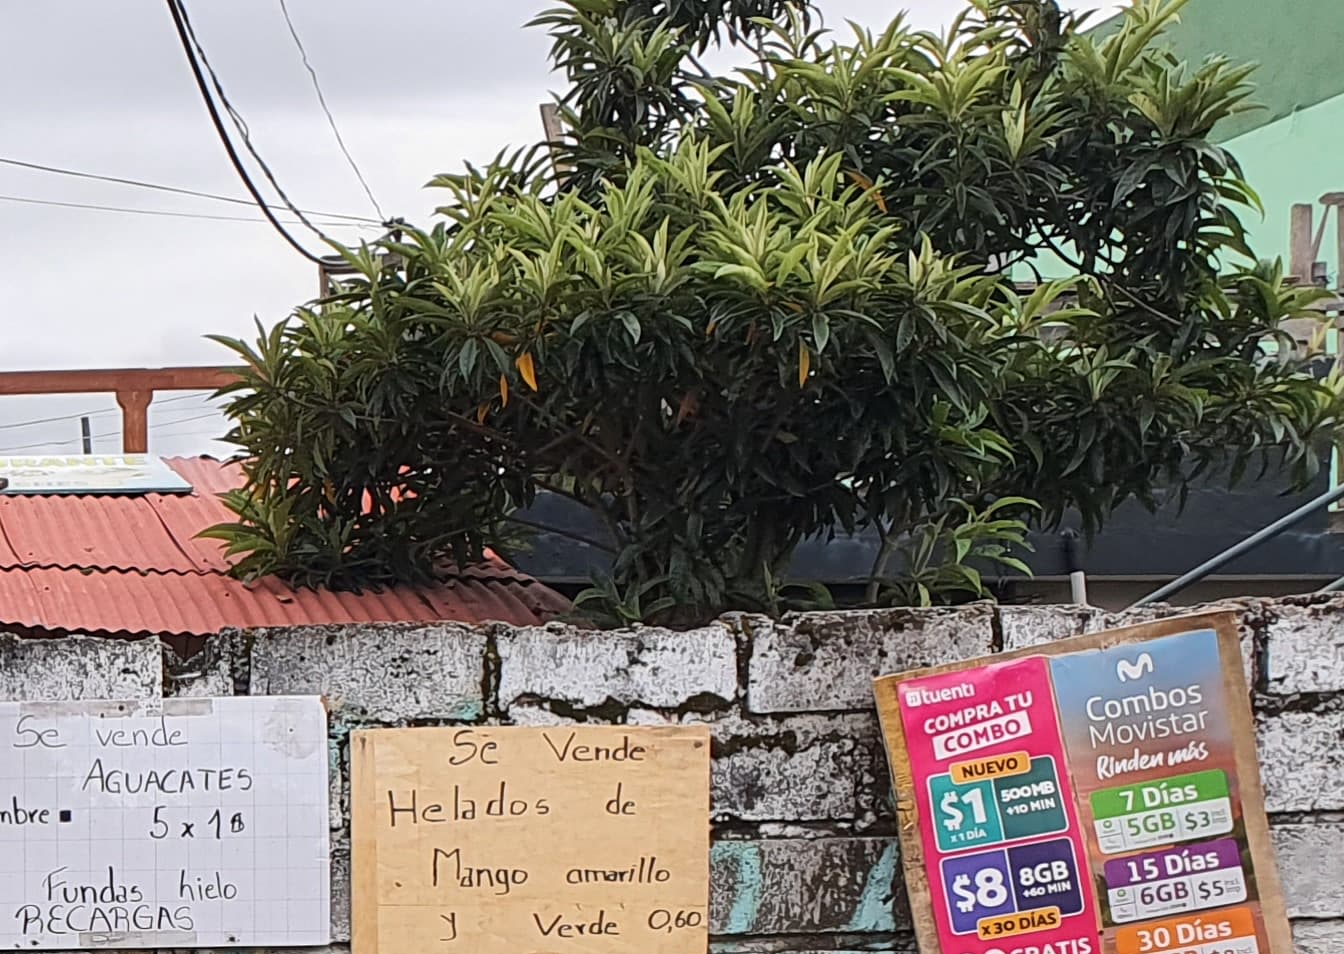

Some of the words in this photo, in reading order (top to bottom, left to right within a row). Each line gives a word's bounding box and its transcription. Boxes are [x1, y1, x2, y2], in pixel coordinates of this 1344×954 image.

[921, 683, 975, 704] tuenti
[1086, 684, 1202, 722] Combos
[924, 701, 1004, 735] COMPRA
[1003, 691, 1033, 712] TU
[13, 714, 67, 748] Se
[96, 715, 188, 747] vende
[944, 718, 1022, 752] COMBO
[1088, 710, 1209, 750] Movistar
[448, 729, 499, 766] Se
[542, 732, 647, 762] Vende
[1096, 747, 1164, 781] Rinden
[1167, 740, 1209, 767] más
[82, 758, 253, 793] AGUACATES
[962, 757, 1018, 778] NUEVO
[388, 781, 550, 827] Helados
[605, 782, 637, 816] de
[940, 787, 988, 831] $1
[1006, 802, 1029, 816] +10
[1030, 797, 1056, 812] MIN
[1119, 790, 1135, 811] 7
[1142, 782, 1199, 808] Días
[149, 806, 169, 839] 5
[180, 821, 194, 837] x
[965, 826, 988, 841] DÍA
[1127, 811, 1176, 837] 5GB
[1185, 811, 1211, 833] $3
[432, 848, 529, 895] Mango
[566, 856, 671, 884] amarillo
[1019, 861, 1069, 886] 8GB
[1127, 858, 1160, 882] 15
[1164, 849, 1220, 876] Días
[42, 866, 143, 904] Fundas
[180, 869, 237, 900] hielo
[952, 867, 1008, 913] $8
[1022, 886, 1046, 899] +60
[1047, 880, 1072, 895] MIN
[1140, 881, 1190, 906] 6GB
[1198, 880, 1225, 901] $5
[15, 904, 194, 934] RECARGAS
[439, 911, 457, 942] y
[533, 910, 620, 938] Verde
[648, 908, 702, 934] 0,60
[981, 924, 992, 936] x
[994, 918, 1016, 935] 30
[1018, 909, 1058, 931] DÍAS
[1136, 927, 1171, 952] 30
[1175, 918, 1233, 945] Días
